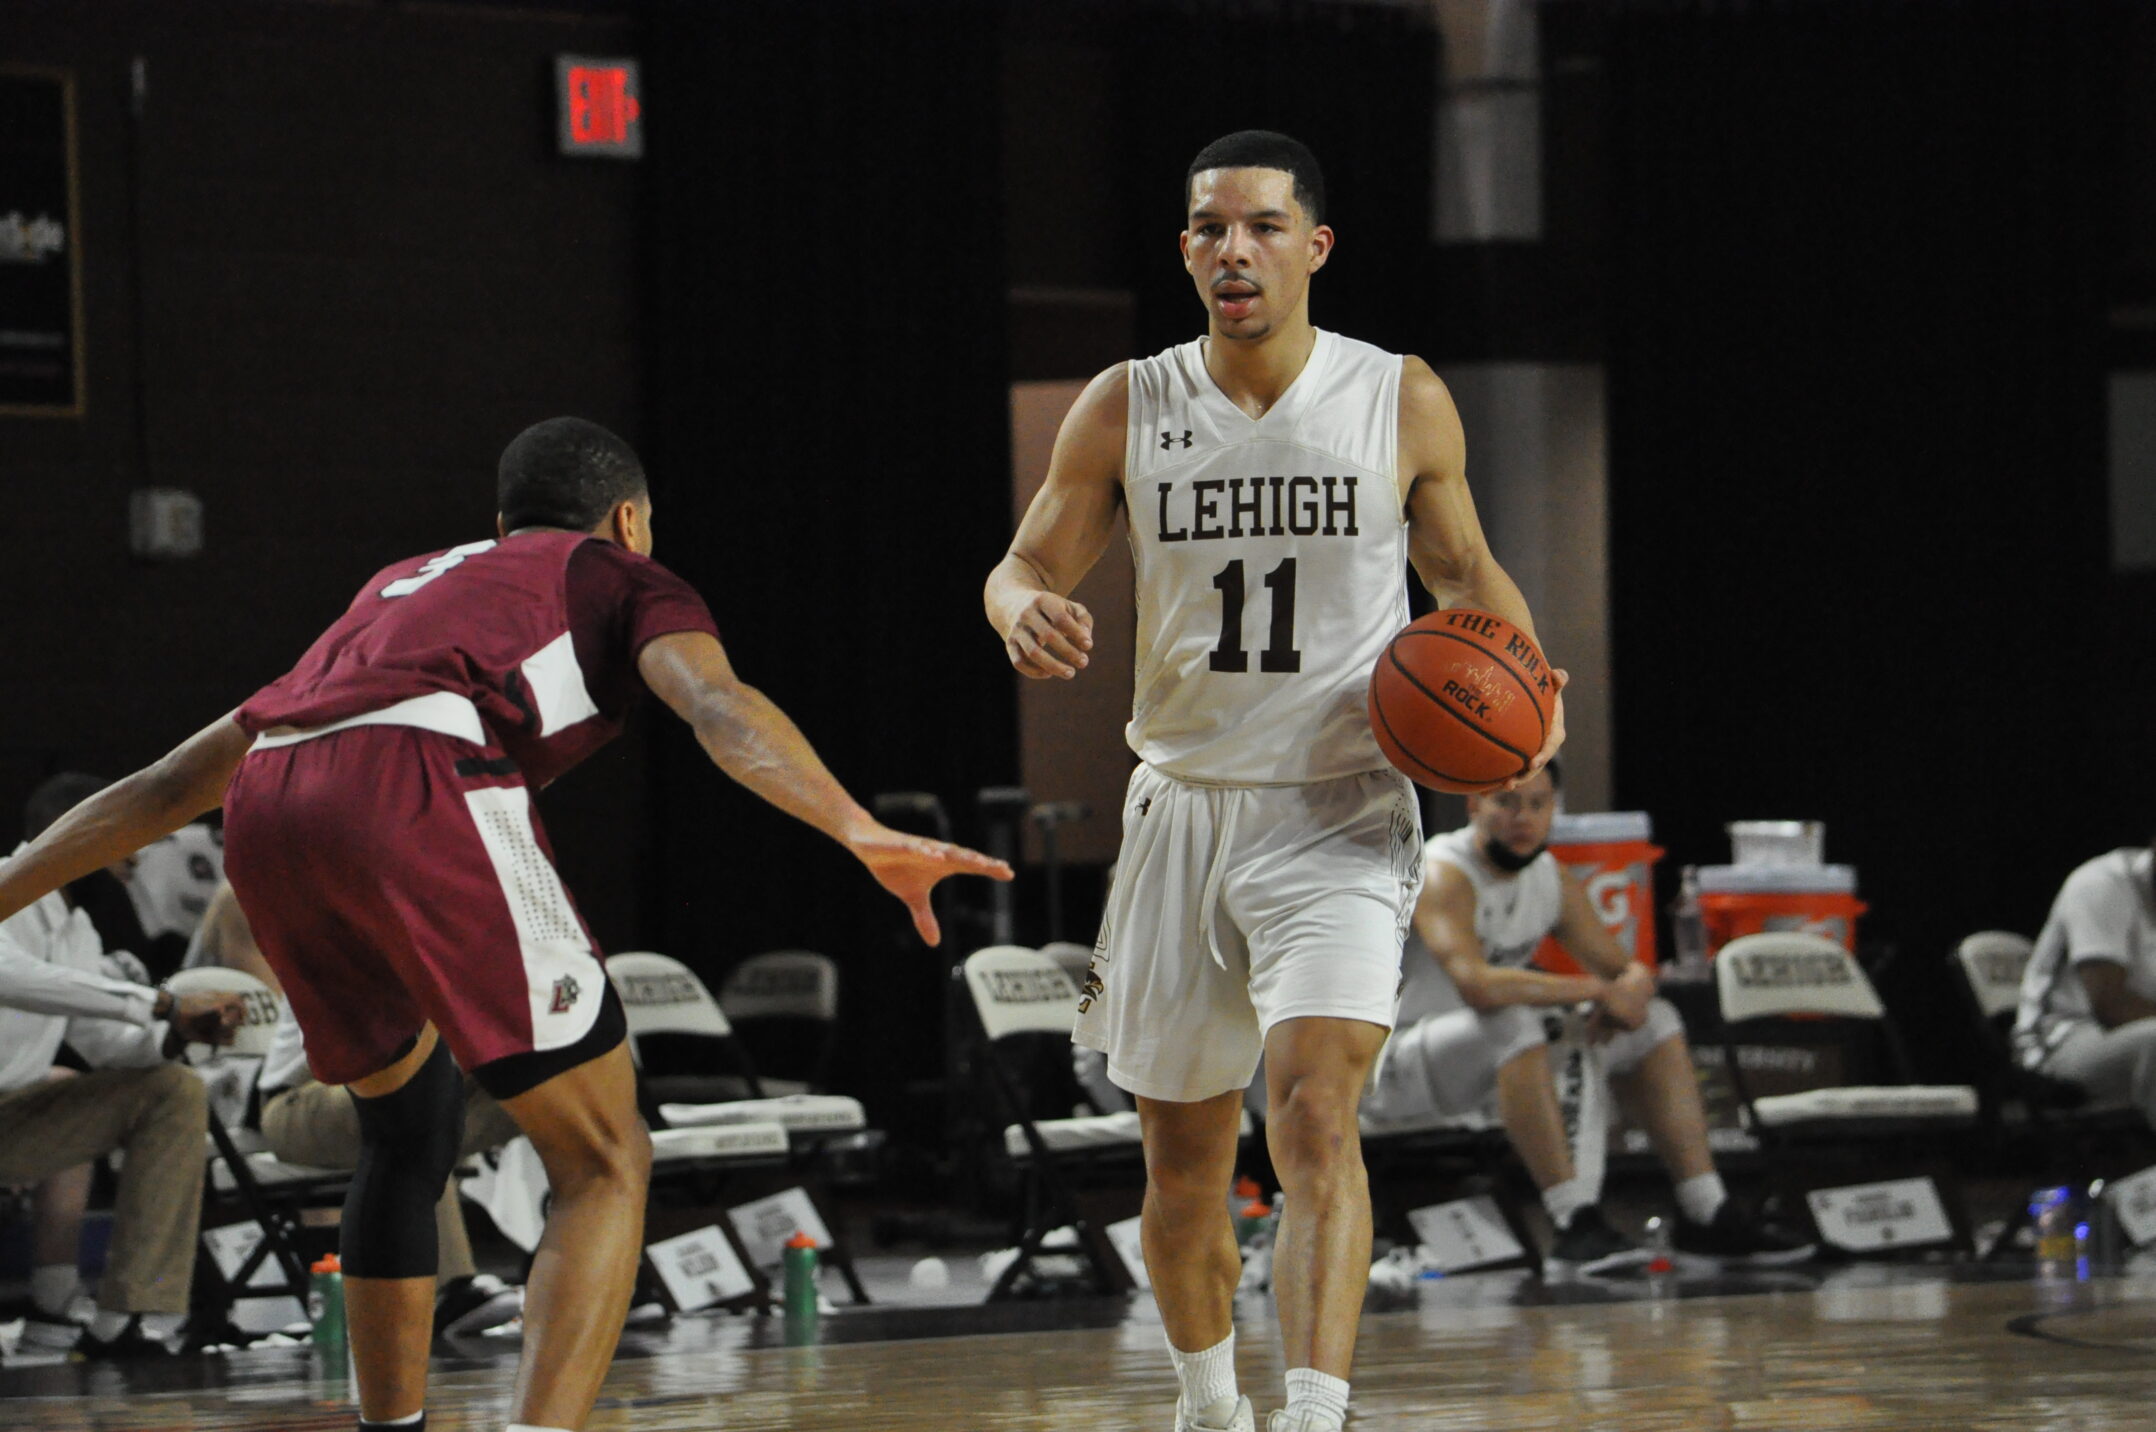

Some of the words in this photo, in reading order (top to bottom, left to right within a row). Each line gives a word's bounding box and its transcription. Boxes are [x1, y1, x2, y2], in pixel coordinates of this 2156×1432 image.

[1158, 476, 1359, 542] LEHIGH
[1208, 557, 1301, 673] 11
[1445, 613, 1501, 640] THE
[1442, 680, 1490, 719] ROCK
[1587, 872, 1628, 925] G
